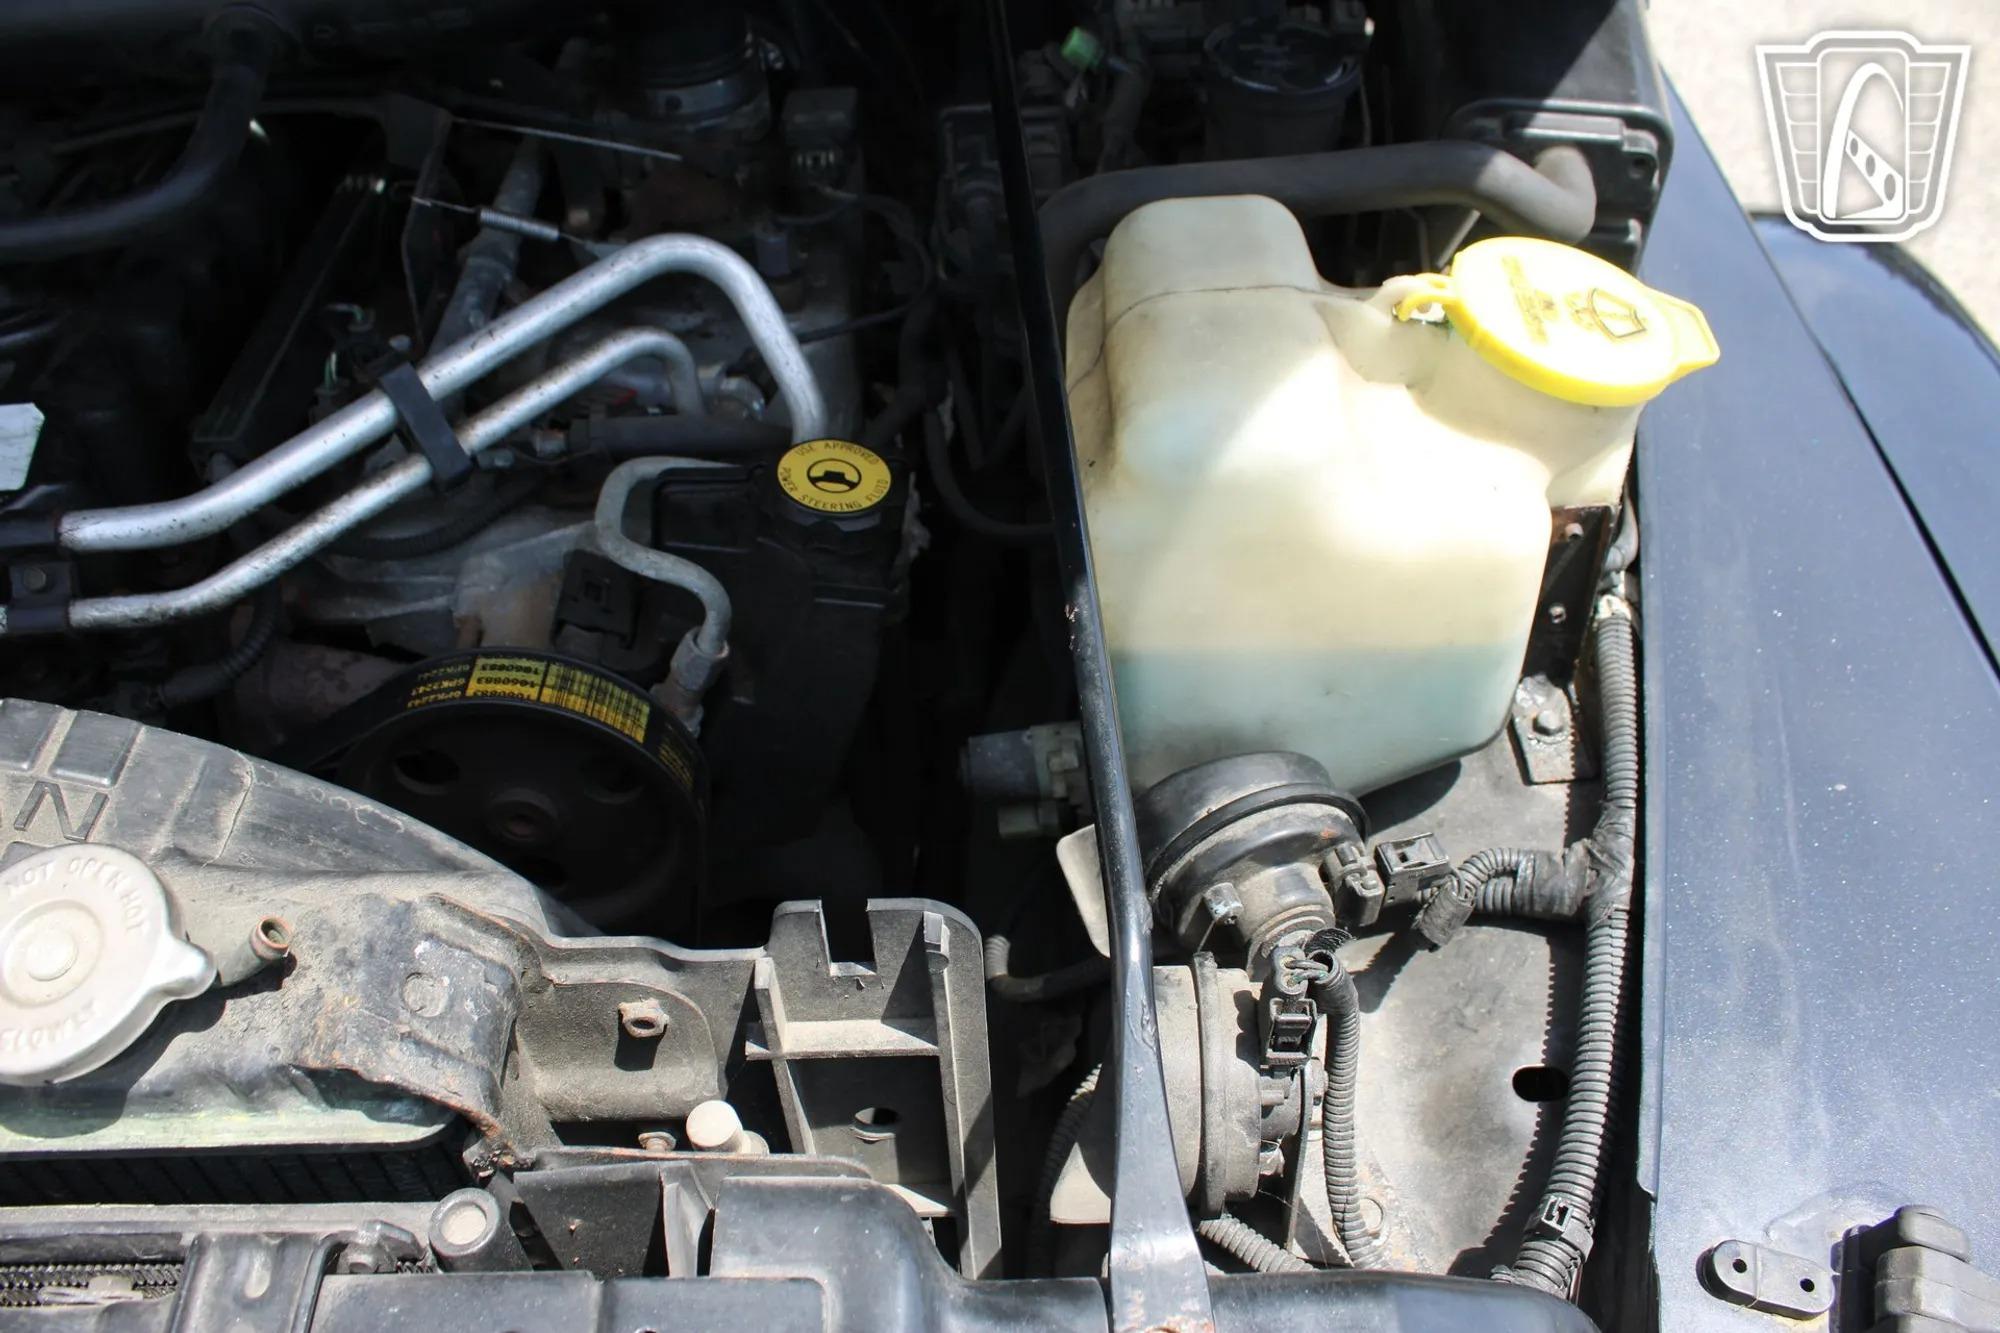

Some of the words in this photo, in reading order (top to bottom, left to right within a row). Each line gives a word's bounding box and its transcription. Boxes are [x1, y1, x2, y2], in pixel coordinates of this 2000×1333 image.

[795, 443, 816, 457] USE
[824, 441, 880, 466] APPROVED
[780, 467, 799, 493] POWER
[799, 494, 863, 511] STEERING
[865, 479, 889, 502] FLUID
